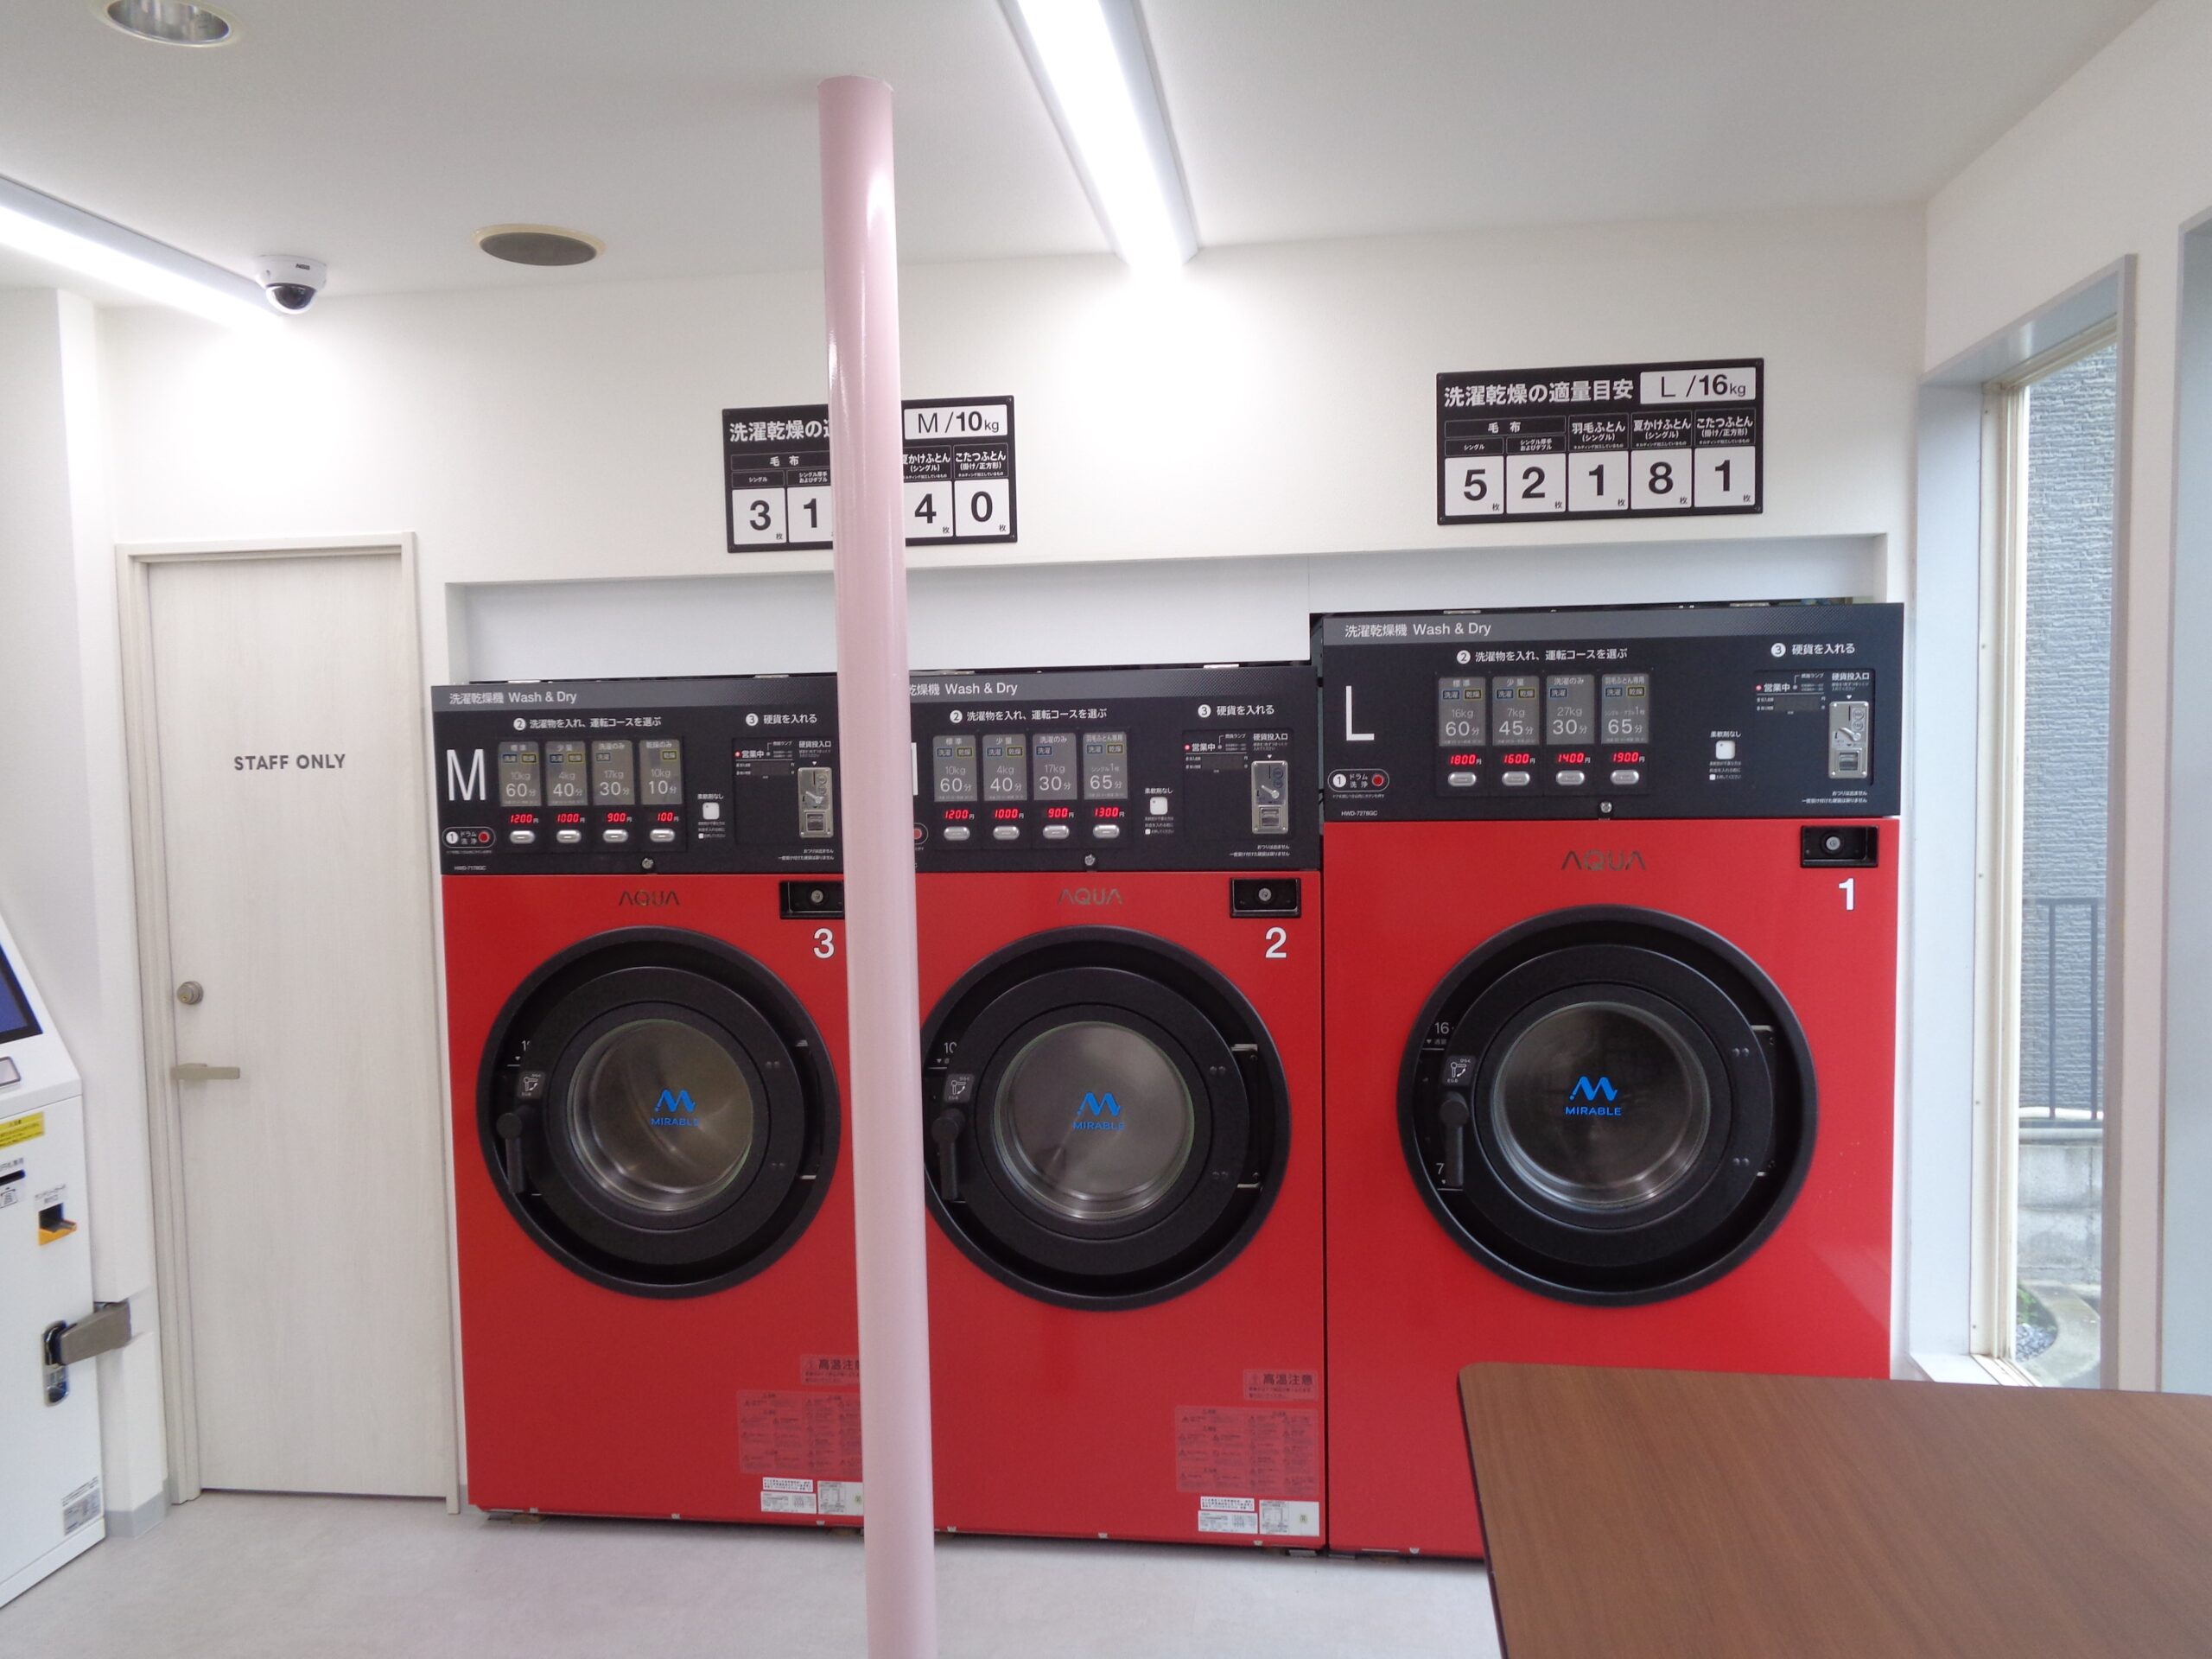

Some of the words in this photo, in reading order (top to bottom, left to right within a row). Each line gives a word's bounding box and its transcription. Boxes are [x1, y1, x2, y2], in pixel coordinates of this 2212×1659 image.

[1444, 378, 1634, 407] 洗濯乾燥の適量目安
[1572, 421, 1625, 433] 羽毛ふとん
[1634, 418, 1692, 431] 夏かけふとん
[1696, 416, 1753, 429] こたつふとん
[956, 450, 1007, 463] こたつふとん
[1589, 464, 1605, 496] 1
[1649, 461, 1674, 494] 8
[1714, 459, 1731, 492] 1
[1463, 468, 1487, 501] 5
[1522, 466, 1546, 499] 2
[803, 498, 817, 528] 1
[914, 493, 937, 524] 4
[970, 491, 993, 522] 0
[749, 499, 772, 531] 3
[1344, 624, 1408, 638] 洗濯乾燥機
[1413, 623, 1451, 635] Wash
[1454, 623, 1465, 635] &
[1469, 622, 1491, 637] Dry
[1792, 643, 1855, 656] 硬貨を入れる
[945, 683, 980, 695] Wash
[983, 683, 993, 694] &
[996, 683, 1018, 696] Dry
[1764, 683, 1790, 692] 営業中
[449, 692, 504, 705] 洗濯乾燥機
[508, 692, 542, 702] Wash
[545, 691, 554, 702] &
[556, 691, 577, 704] Dry
[1217, 705, 1274, 716] 硬貨を入れる
[1345, 685, 1376, 741] L
[1452, 709, 1473, 720] 16kg
[1507, 708, 1525, 719] 7kg
[1557, 707, 1583, 718] 27kg
[763, 714, 817, 724] 硬貨を入れる
[1192, 743, 1216, 752] 営業中
[741, 750, 765, 759] 営業中
[234, 755, 289, 771] STAFF
[296, 753, 346, 769] ONLY
[446, 748, 486, 801] M
[945, 766, 966, 775] 10kg
[996, 766, 1014, 775] 4kg
[1045, 764, 1065, 774] 17kg
[1561, 849, 1646, 871] AQUA
[619, 890, 680, 906] AQUA
[1058, 888, 1123, 906] AQUA
[1838, 877, 1854, 911] 1
[813, 927, 835, 959] 3
[1265, 927, 1287, 958] 2
[1435, 1022, 1449, 1034] 16
[1566, 1106, 1622, 1116] MIRABLE
[651, 1117, 700, 1127] MIRABLE
[1073, 1122, 1125, 1130] MIRABLE
